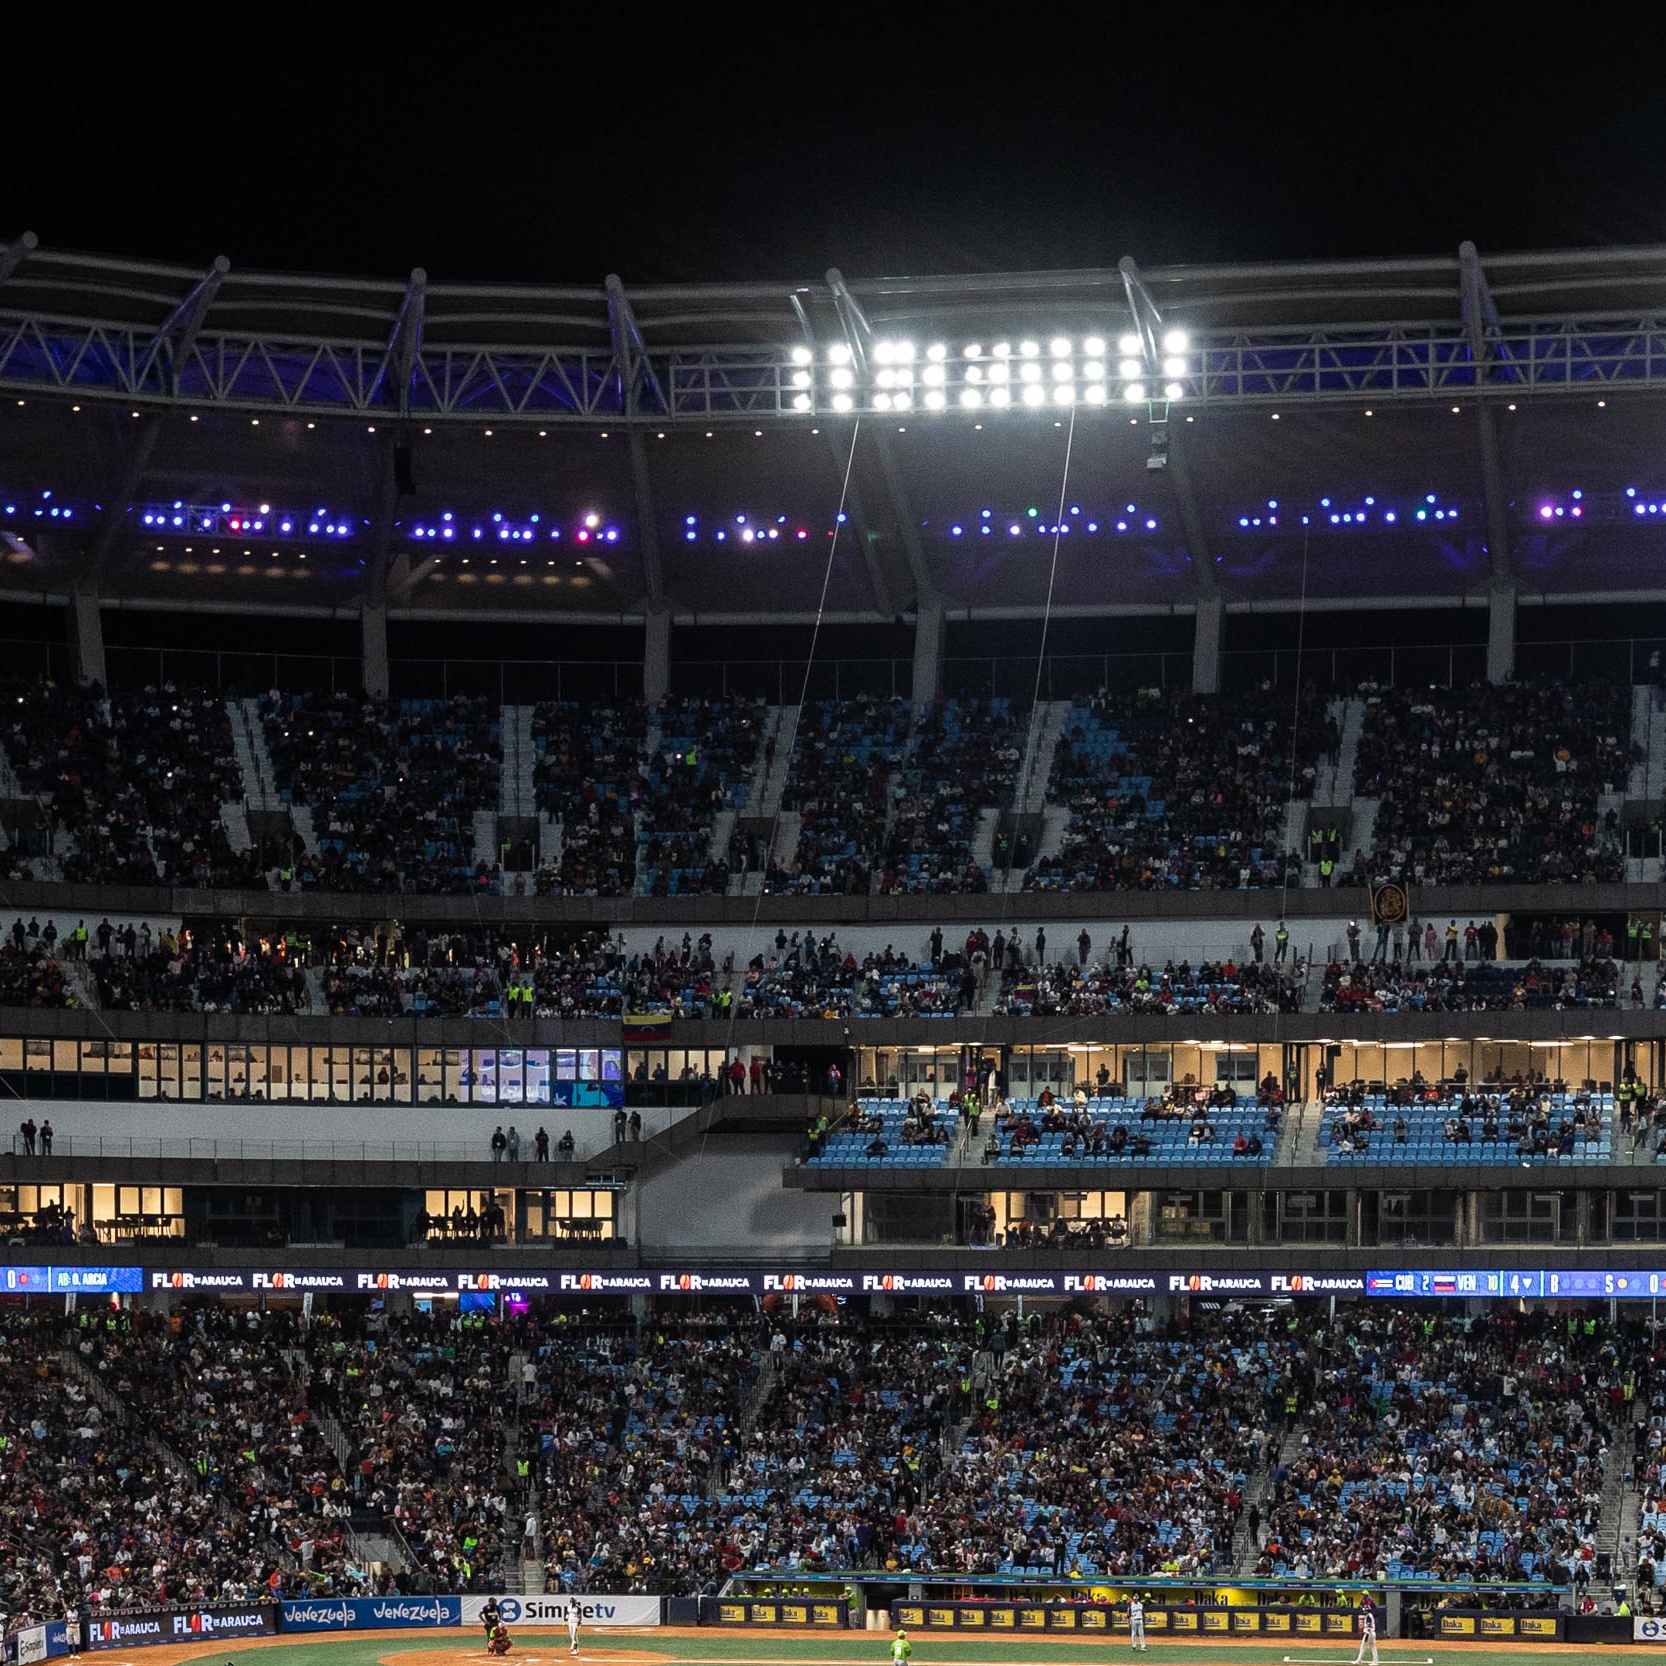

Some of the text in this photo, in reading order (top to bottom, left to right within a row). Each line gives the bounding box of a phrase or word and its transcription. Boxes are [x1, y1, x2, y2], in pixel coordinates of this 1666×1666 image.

[82, 1273, 108, 1286] ARCIA
[152, 1272, 242, 1287] FLOR ARAUCA
[252, 1272, 343, 1288] FLOR ARAUCA
[357, 1273, 448, 1288] FLOR ARAUCA
[457, 1274, 548, 1289] FLOR ARAUCA
[560, 1274, 650, 1289] FLOR ARAUCA
[660, 1274, 749, 1289] FLOR ARAUCA
[763, 1274, 853, 1289] FLOR ARAUCA
[862, 1275, 952, 1290] FLOR ARAUCA
[964, 1275, 1054, 1290] FLOR ARAUCA
[1064, 1275, 1155, 1290] FLOR ARAUCA
[1169, 1275, 1261, 1290] FLOR ARAUCA
[1270, 1275, 1363, 1290] FLOR ARAUCA
[1395, 1274, 1414, 1291] CUB
[1422, 1274, 1430, 1291] 2
[1457, 1274, 1477, 1291] VEN
[1487, 1275, 1499, 1291] 10
[1510, 1274, 1519, 1294] 4
[1550, 1274, 1559, 1293] B
[1605, 1274, 1614, 1293] S
[1194, 1590, 1228, 1606] Daka
[284, 1601, 356, 1627] Venezuela
[373, 1599, 450, 1625] Venezuela
[89, 1620, 120, 1642] FLOR
[125, 1622, 161, 1635] ARAUCA
[173, 1614, 213, 1634] FLOR
[220, 1614, 264, 1628] ARAUCA
[1443, 1620, 1463, 1628] Daka
[1482, 1620, 1502, 1629] Daka
[1521, 1621, 1542, 1629] Daka
